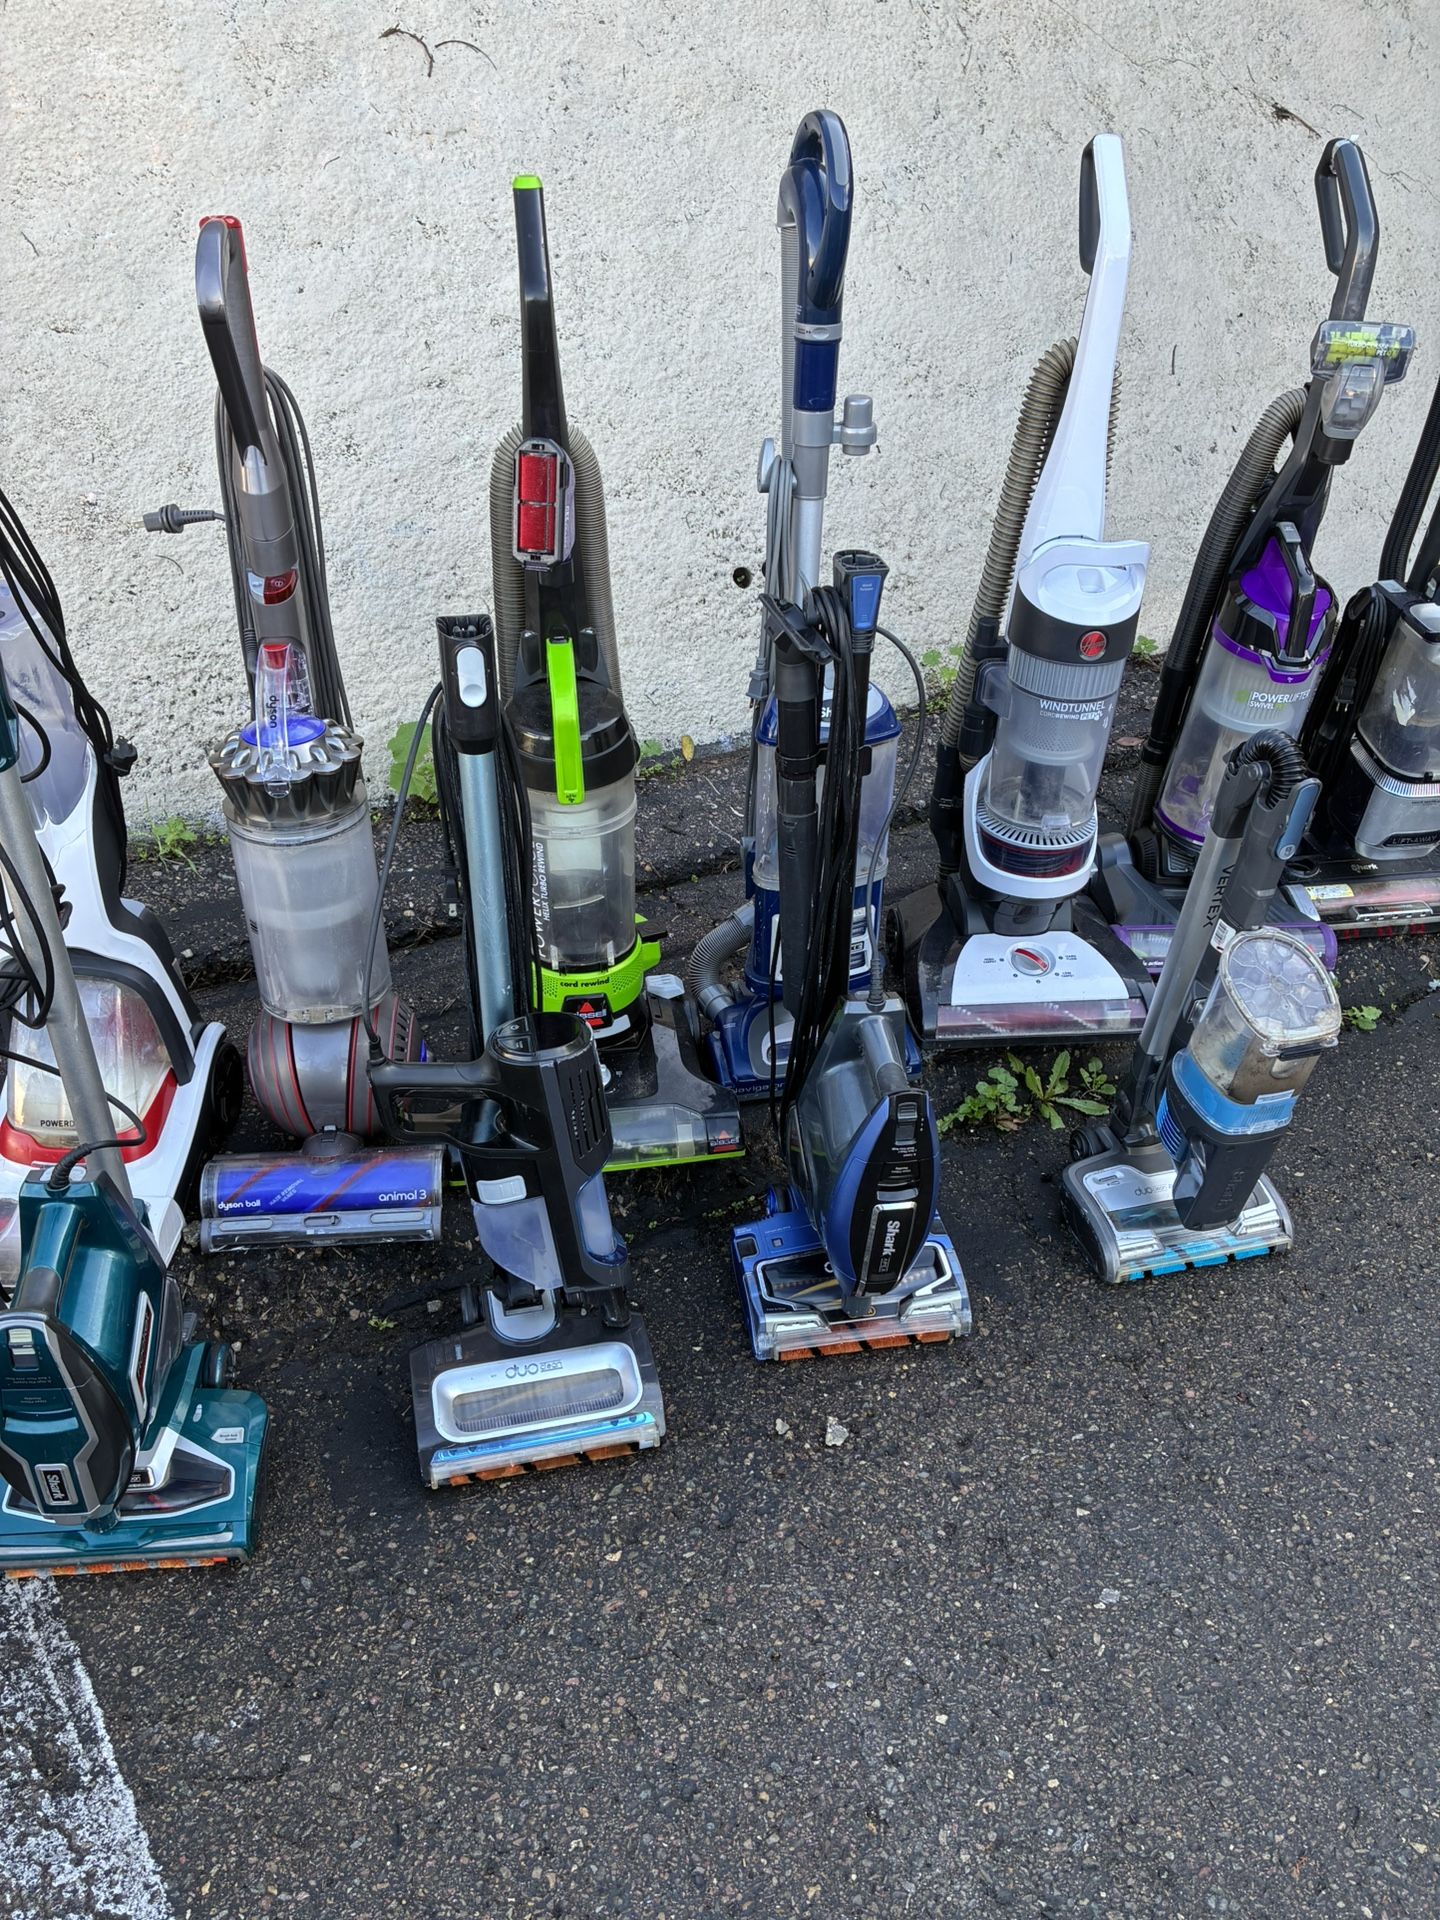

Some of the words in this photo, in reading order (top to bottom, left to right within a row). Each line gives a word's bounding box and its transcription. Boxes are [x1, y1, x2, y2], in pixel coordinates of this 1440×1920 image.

[266, 695, 280, 728] dyson
[1040, 699, 1105, 713] WINDTUNNEL
[1249, 700, 1274, 710] SWIVEL
[1392, 836, 1438, 844] LIFT-AWAY
[535, 842, 546, 874] REWIND
[1350, 863, 1379, 873] Shark
[539, 874, 548, 899] TURBO
[1202, 863, 1236, 928] VERTEX
[542, 900, 550, 921] HELIX
[581, 977, 610, 988] rewind
[735, 1082, 785, 1095] Navigaor
[378, 1190, 418, 1202] animal
[419, 1189, 427, 1200] 3
[218, 1201, 244, 1211] dyson
[245, 1199, 261, 1207] ball
[882, 1220, 901, 1257] Shark
[505, 1363, 539, 1379] duo
[46, 1473, 66, 1500] Shark
